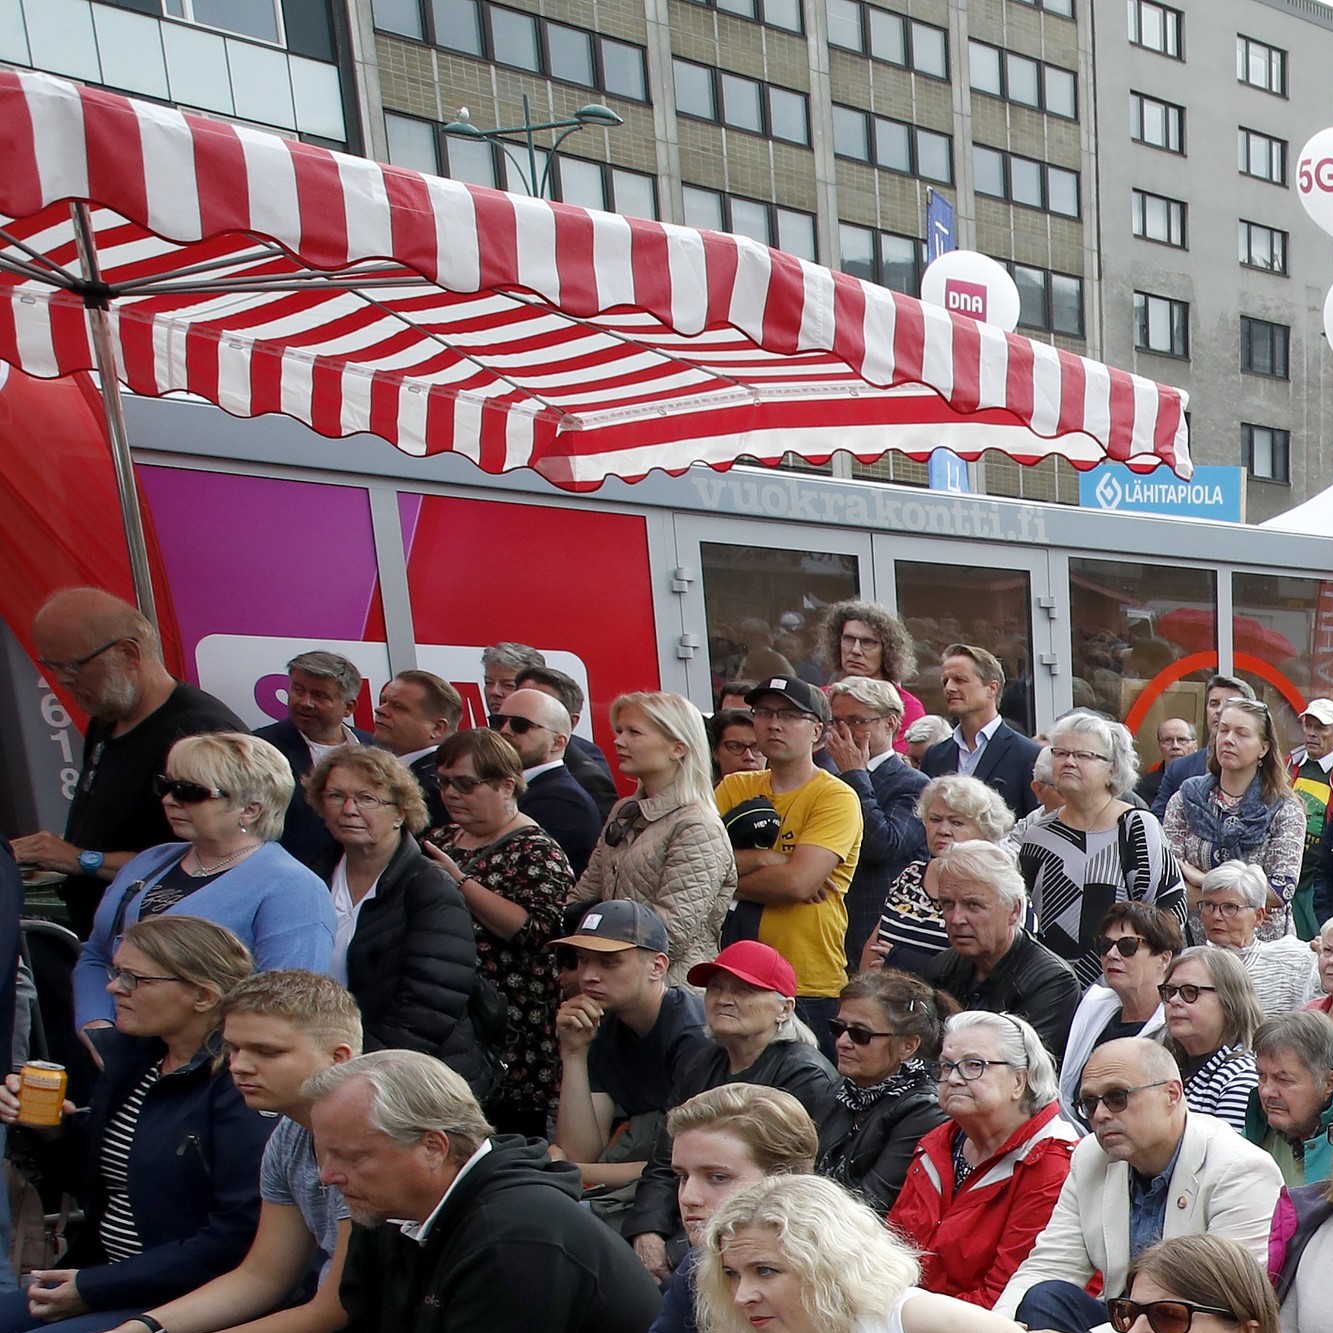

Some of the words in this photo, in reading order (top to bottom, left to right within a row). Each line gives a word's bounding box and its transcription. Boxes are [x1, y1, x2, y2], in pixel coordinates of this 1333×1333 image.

[948, 291, 983, 313] DNA
[1125, 480, 1223, 505] LÄHITAPIOLA
[691, 476, 1050, 545] vuokrakontti.fi
